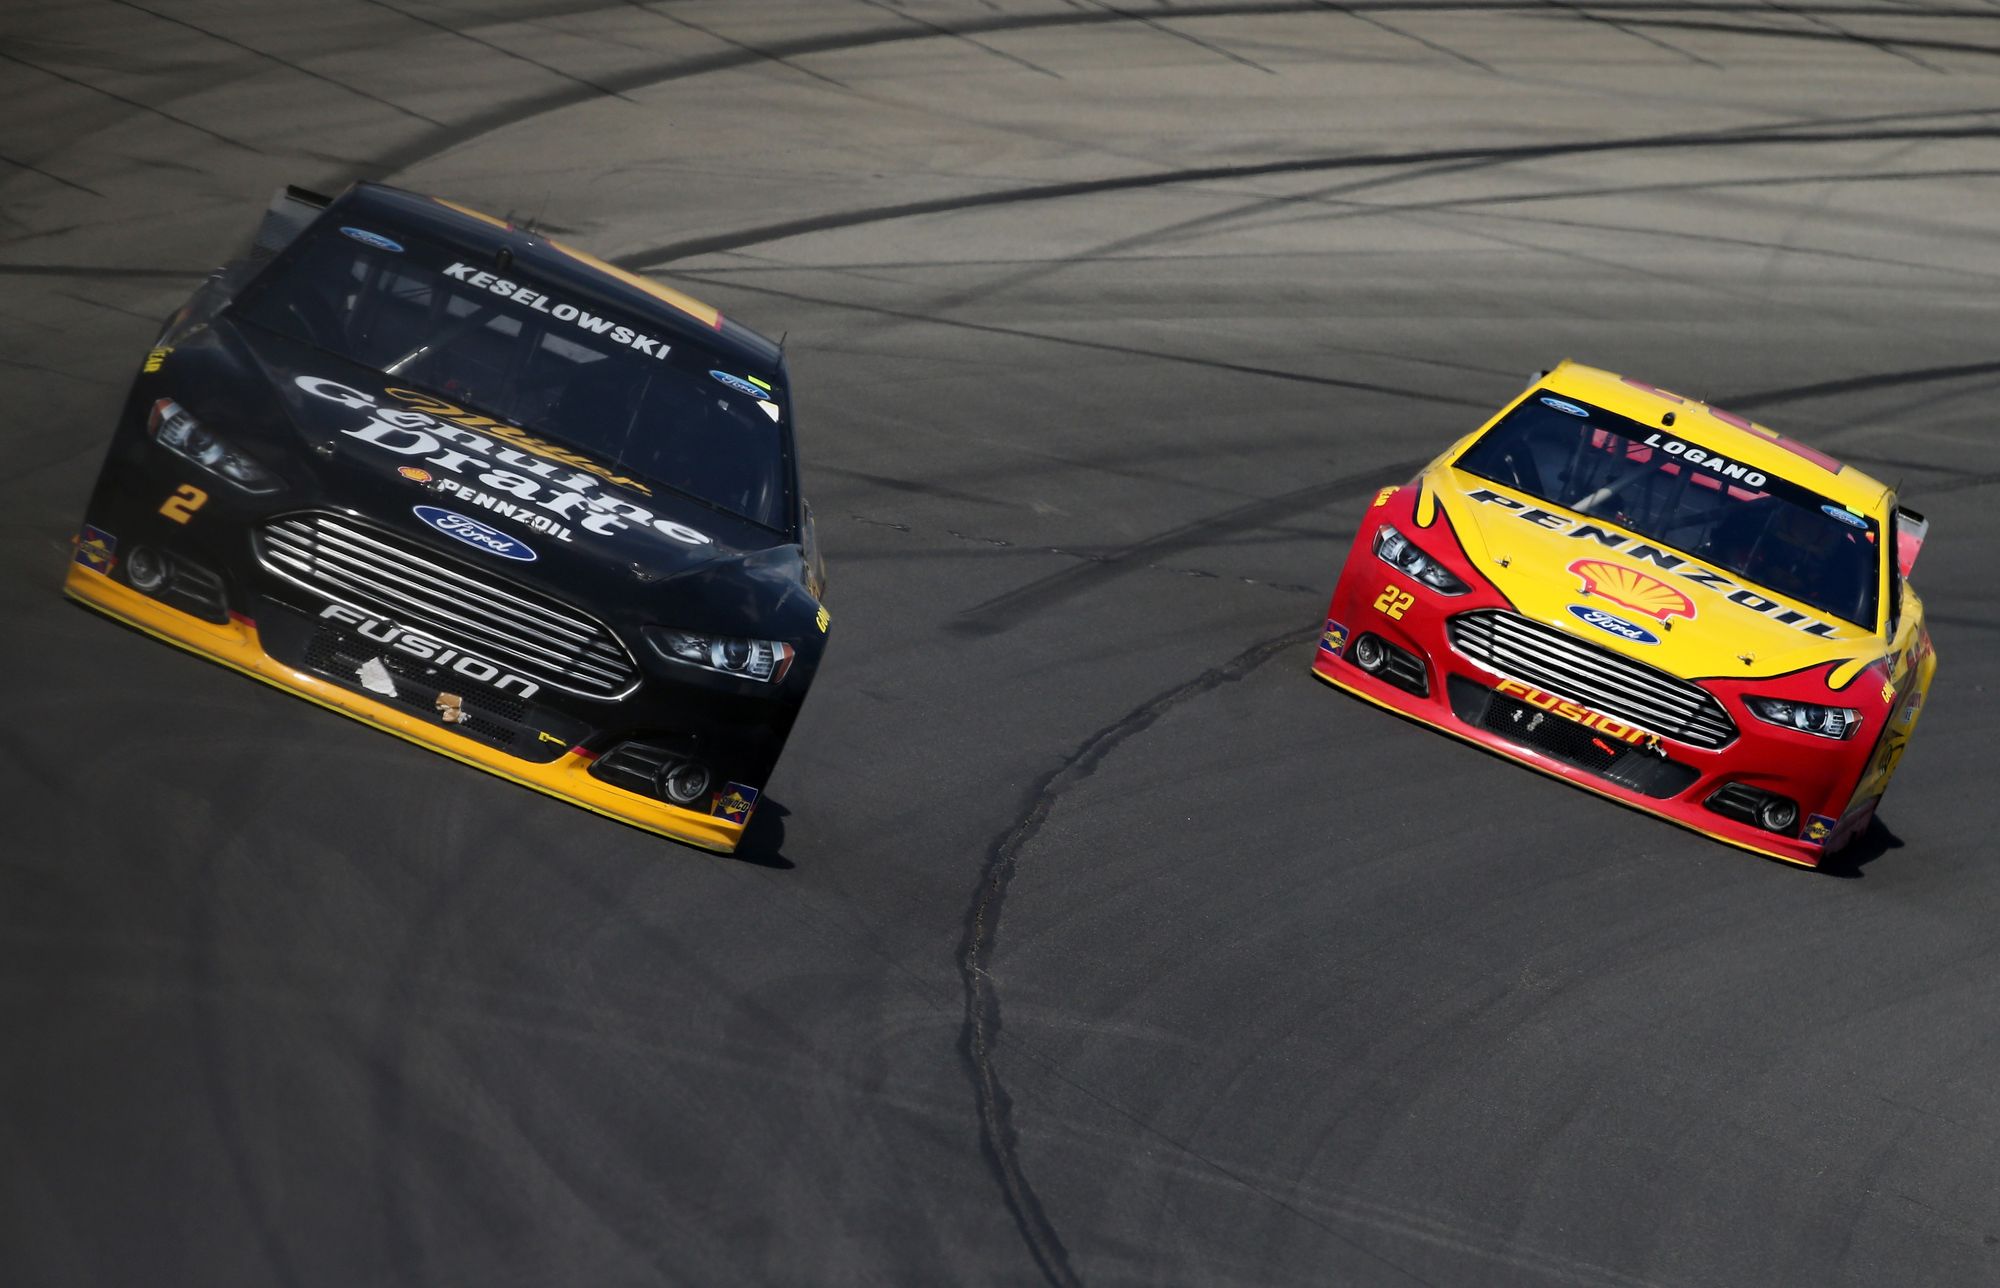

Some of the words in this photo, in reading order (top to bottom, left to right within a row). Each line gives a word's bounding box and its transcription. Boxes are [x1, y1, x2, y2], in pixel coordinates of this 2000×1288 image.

[443, 262, 671, 361] KESELOWSKI
[295, 375, 711, 545] Genuine
[340, 415, 629, 536] Draft
[1643, 434, 1767, 488] LOGANO
[158, 484, 208, 524] 2
[436, 512, 510, 554] Ford
[441, 478, 573, 542] PENNZOIL
[1466, 488, 1845, 640] PENNZOIL
[1373, 584, 1415, 621] 22
[1582, 610, 1641, 641] Ford
[319, 604, 540, 699] FUSION
